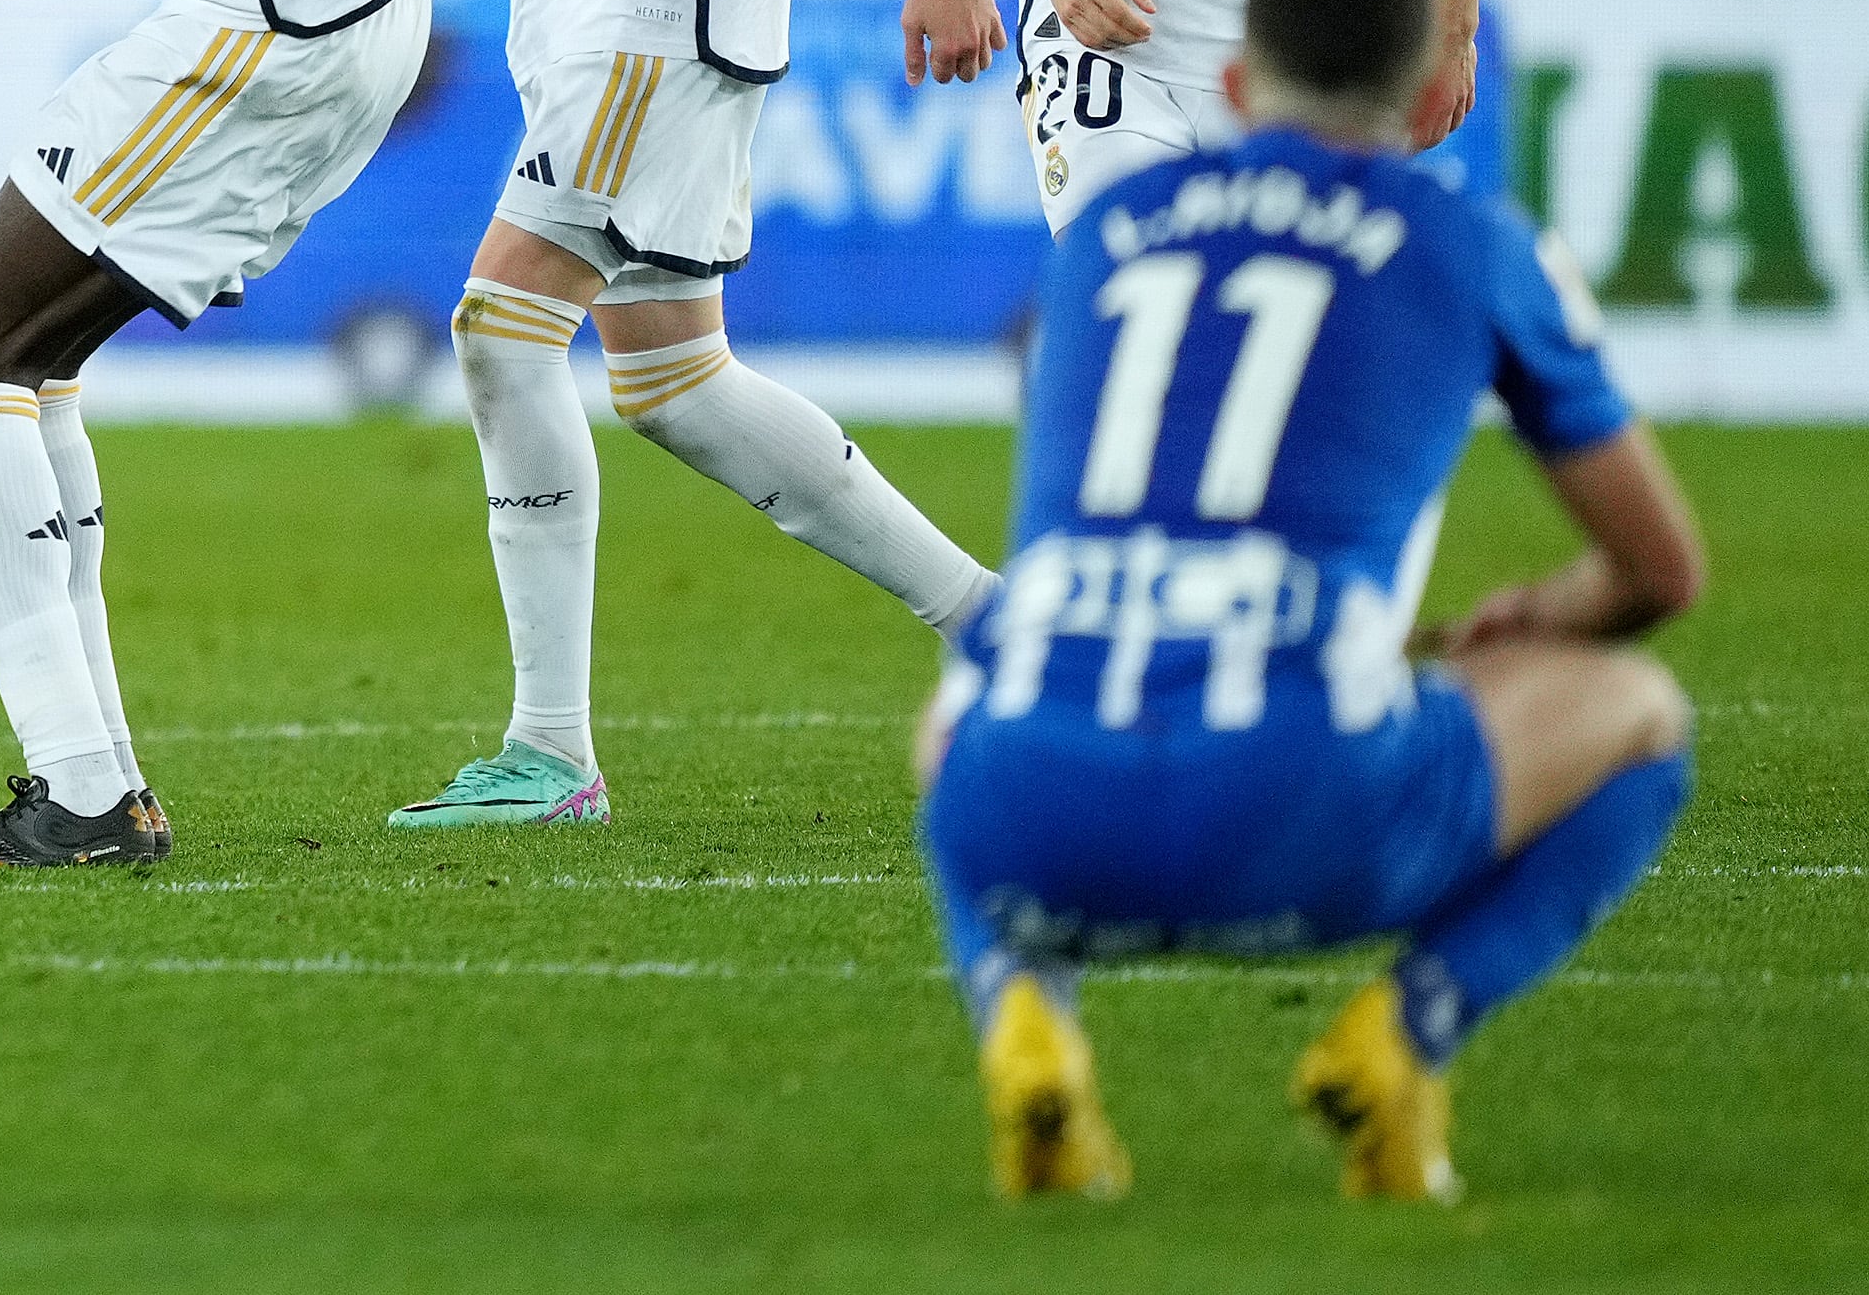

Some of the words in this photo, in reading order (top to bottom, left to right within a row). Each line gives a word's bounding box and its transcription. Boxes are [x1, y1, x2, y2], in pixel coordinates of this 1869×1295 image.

[635, 5, 661, 20] HEAT
[663, 9, 683, 23] RDY
[1037, 51, 1124, 145] 20
[1079, 252, 1335, 519] 11
[488, 489, 574, 509] RMCF
[753, 491, 781, 511] CF
